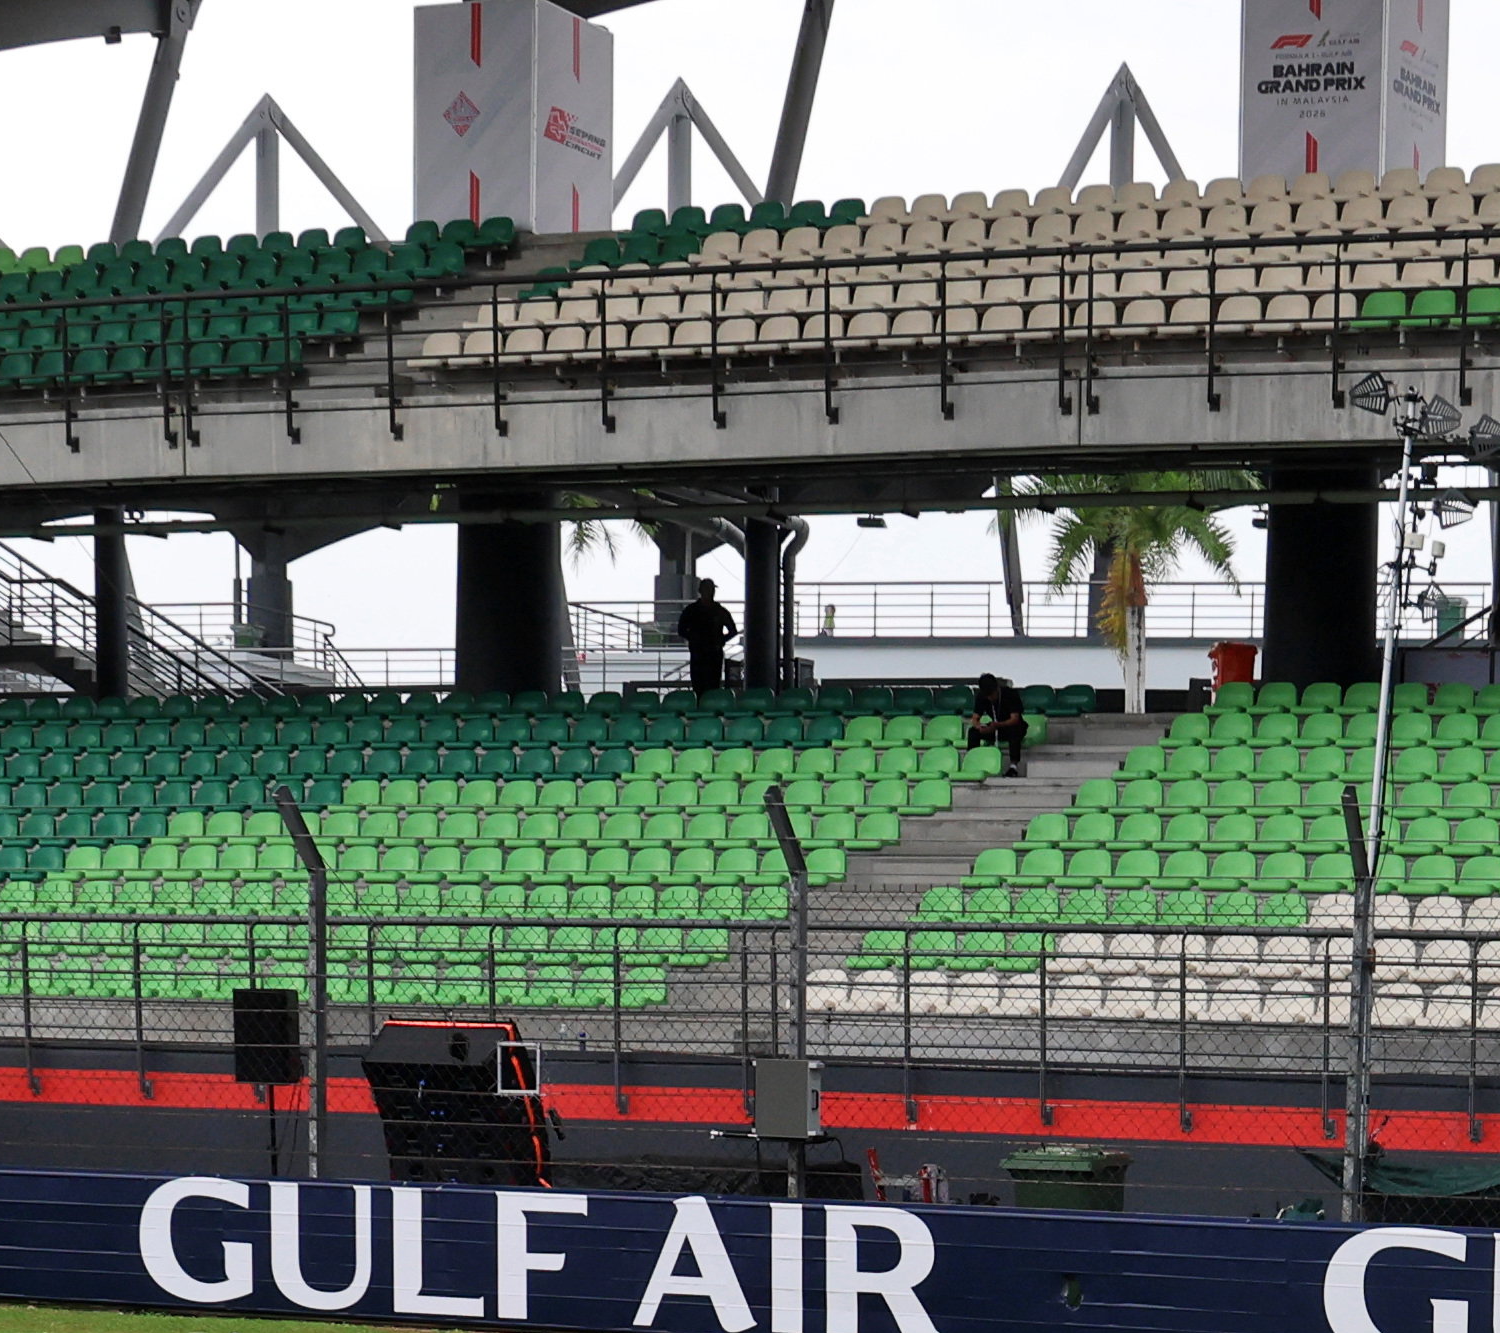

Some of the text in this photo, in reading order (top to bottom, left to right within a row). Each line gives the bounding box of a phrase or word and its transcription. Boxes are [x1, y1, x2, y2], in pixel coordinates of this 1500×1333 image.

[1273, 61, 1355, 78] BAHRAIN
[1257, 76, 1366, 94] GRAND PRIX
[1400, 67, 1437, 97] BAHRAIN
[1277, 95, 1349, 106] IN MALAYSIA
[569, 126, 606, 147] SEPANG
[564, 141, 602, 160] CIRCUIT
[139, 1176, 588, 1320] GULF
